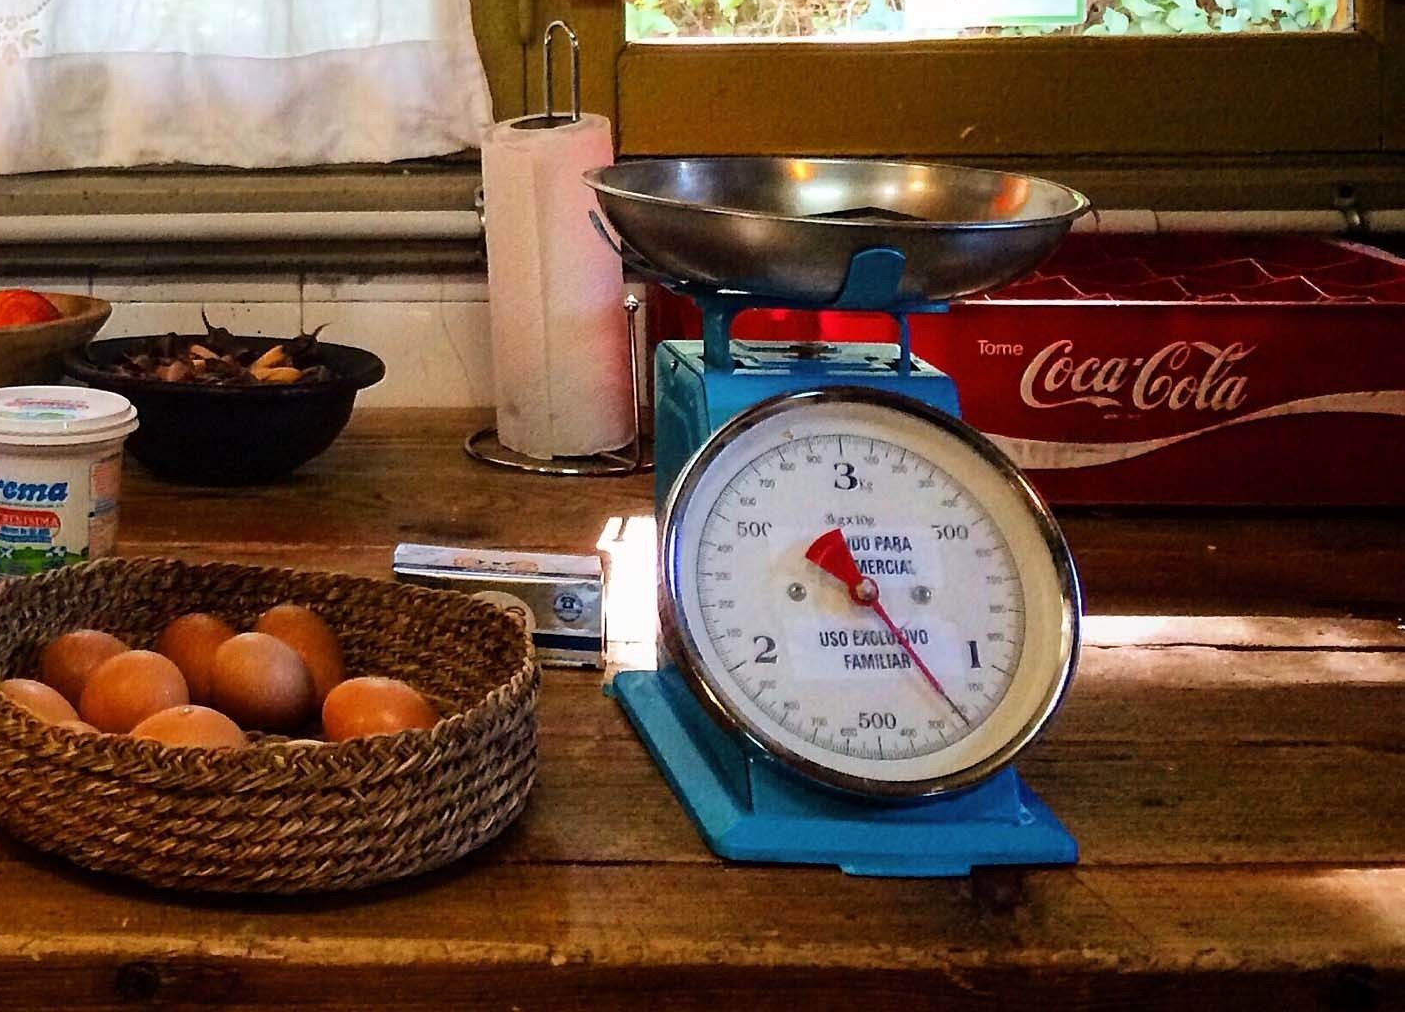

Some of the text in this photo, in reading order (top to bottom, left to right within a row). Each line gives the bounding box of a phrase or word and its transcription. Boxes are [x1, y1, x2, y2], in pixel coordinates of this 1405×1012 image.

[977, 340, 1024, 356] Tome
[1020, 339, 1257, 410] Coca-Cola
[834, 462, 858, 490] 3
[874, 535, 913, 552] PARA
[854, 558, 916, 576] MERCIAL
[819, 630, 848, 647] USO
[753, 635, 779, 665] 2
[966, 640, 982, 669] 1
[844, 653, 912, 670] FAMILIAR
[858, 712, 897, 730] 500
